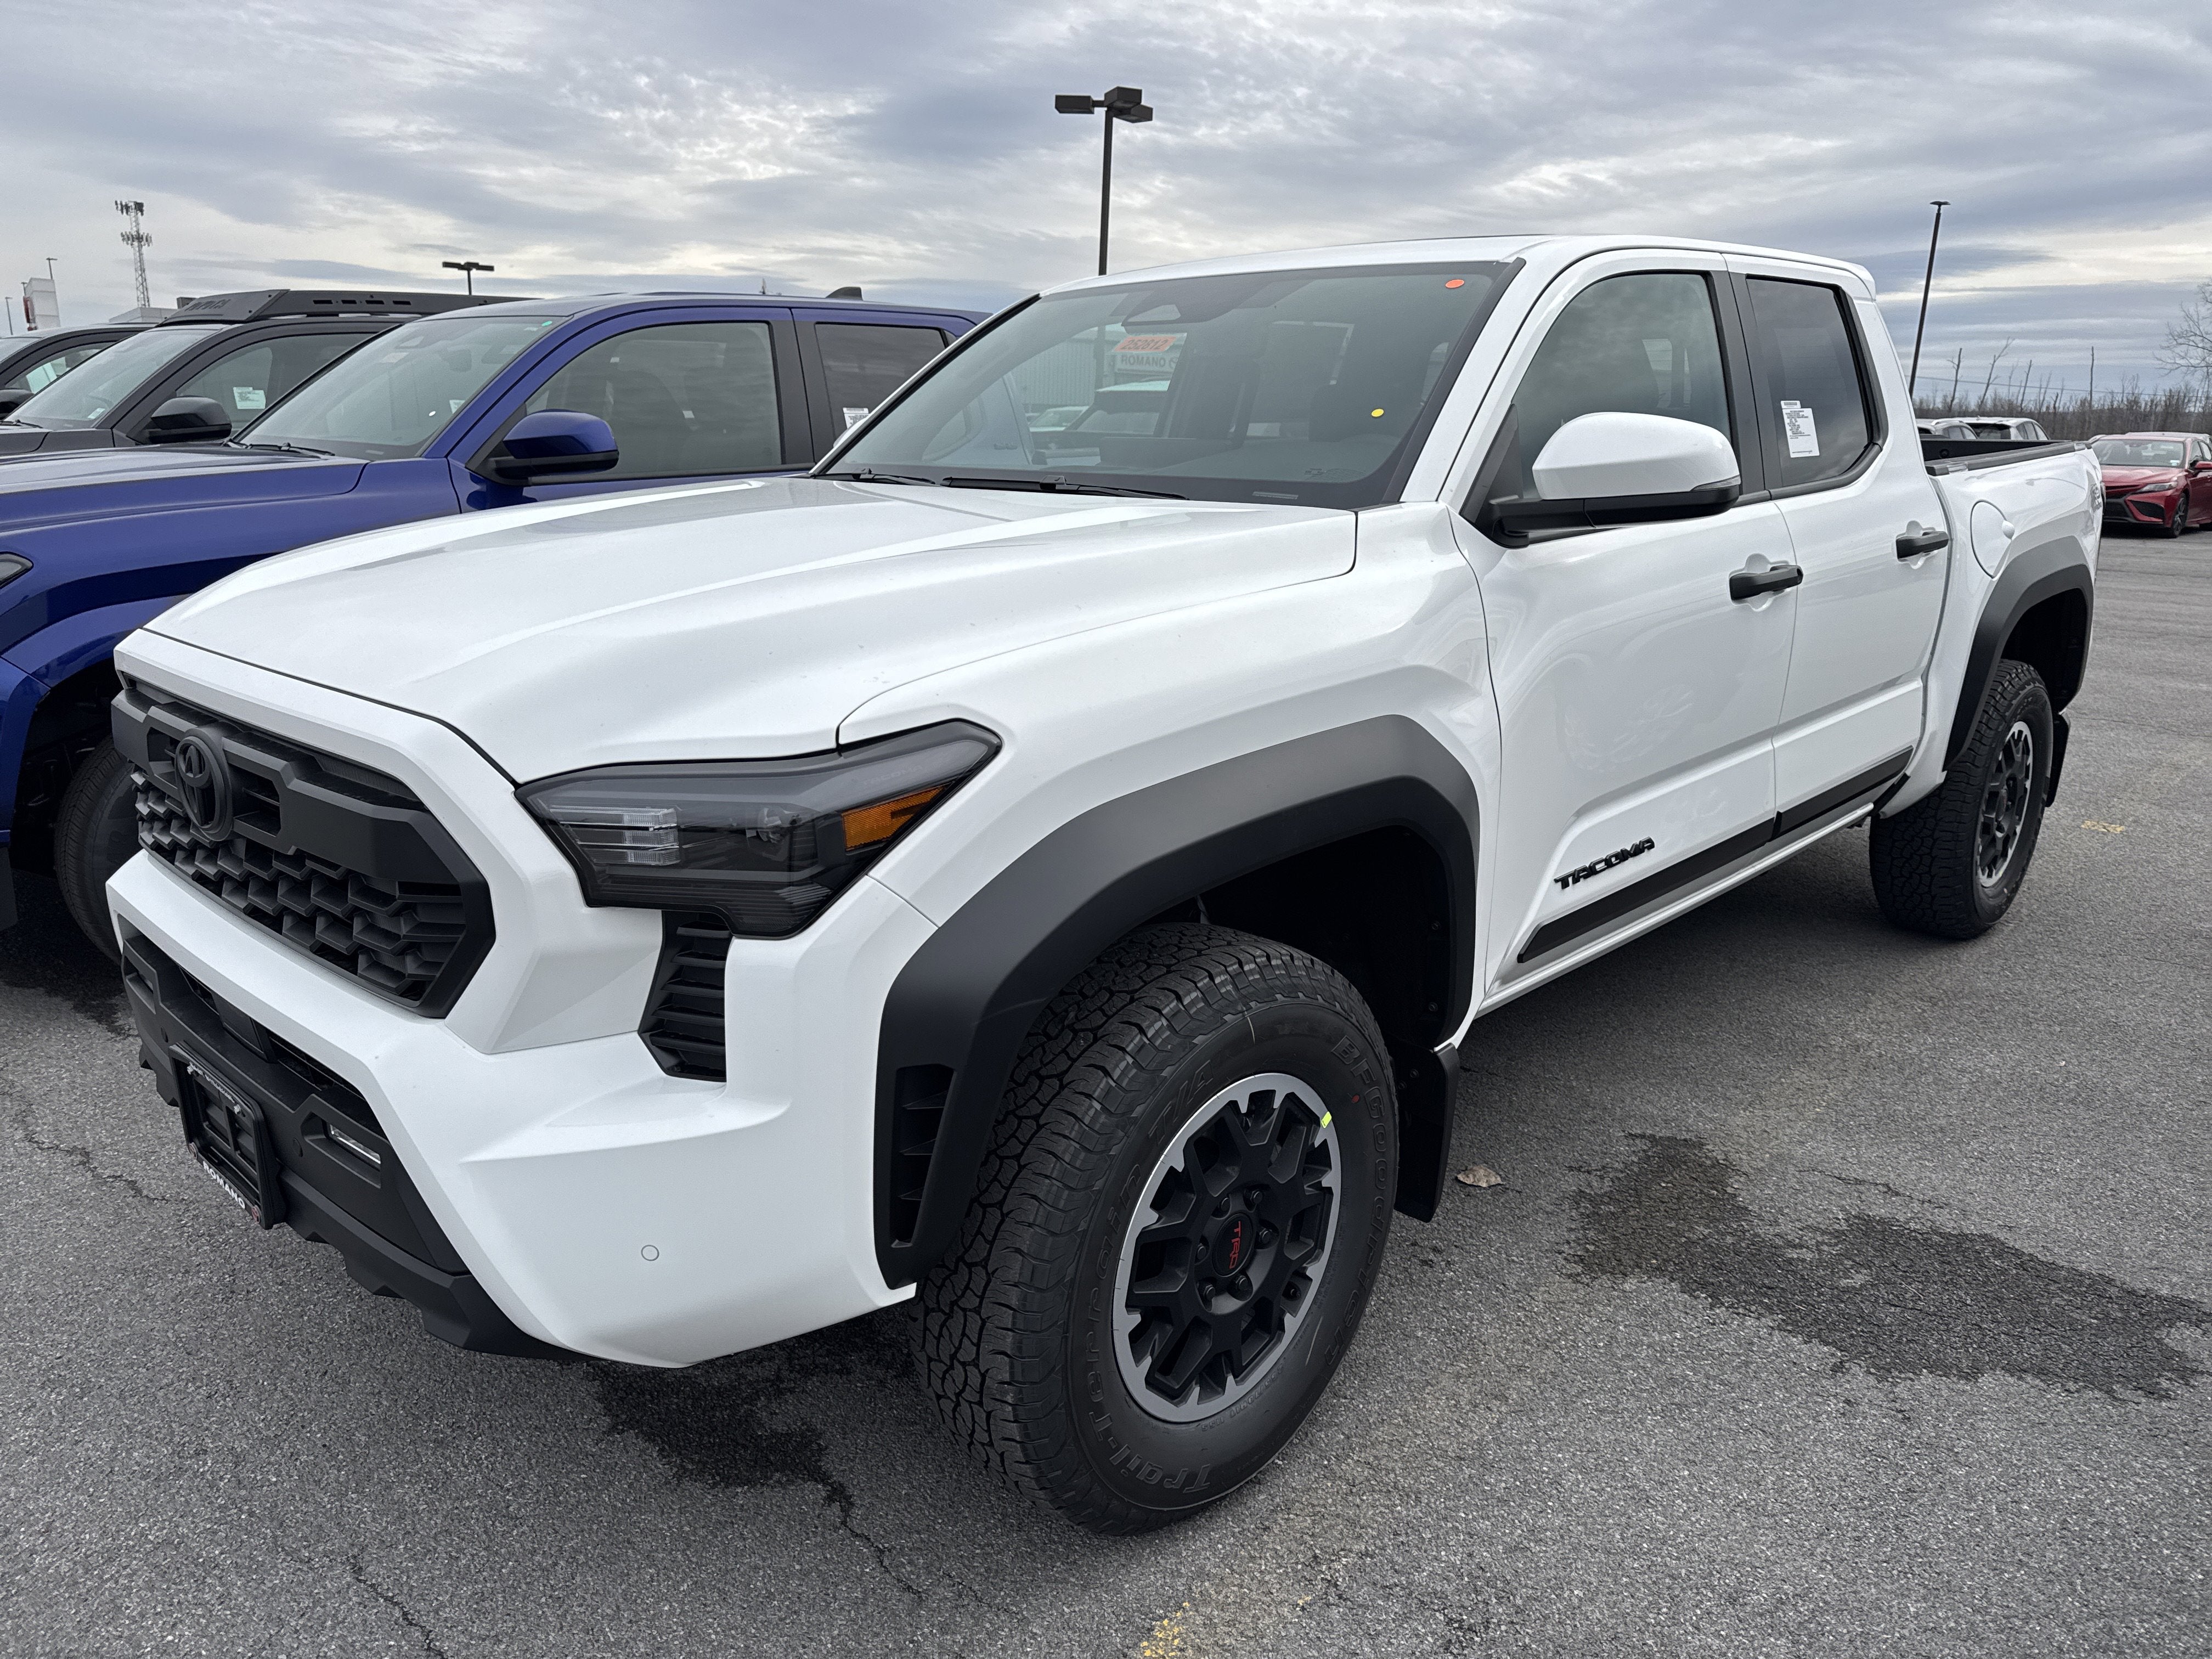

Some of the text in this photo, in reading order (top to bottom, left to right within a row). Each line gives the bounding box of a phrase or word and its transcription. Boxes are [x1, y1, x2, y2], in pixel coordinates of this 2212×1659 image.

[1120, 338, 1169, 350] 252812
[1121, 354, 1166, 368] ROMANO
[1554, 837, 1655, 889] TACOMA
[202, 1160, 246, 1209] ROMANO
[1324, 1034, 1389, 1366] BFGoodrich
[1229, 1221, 1242, 1269] TRD
[1085, 1059, 1215, 1494] Trail-Terrain T/A
